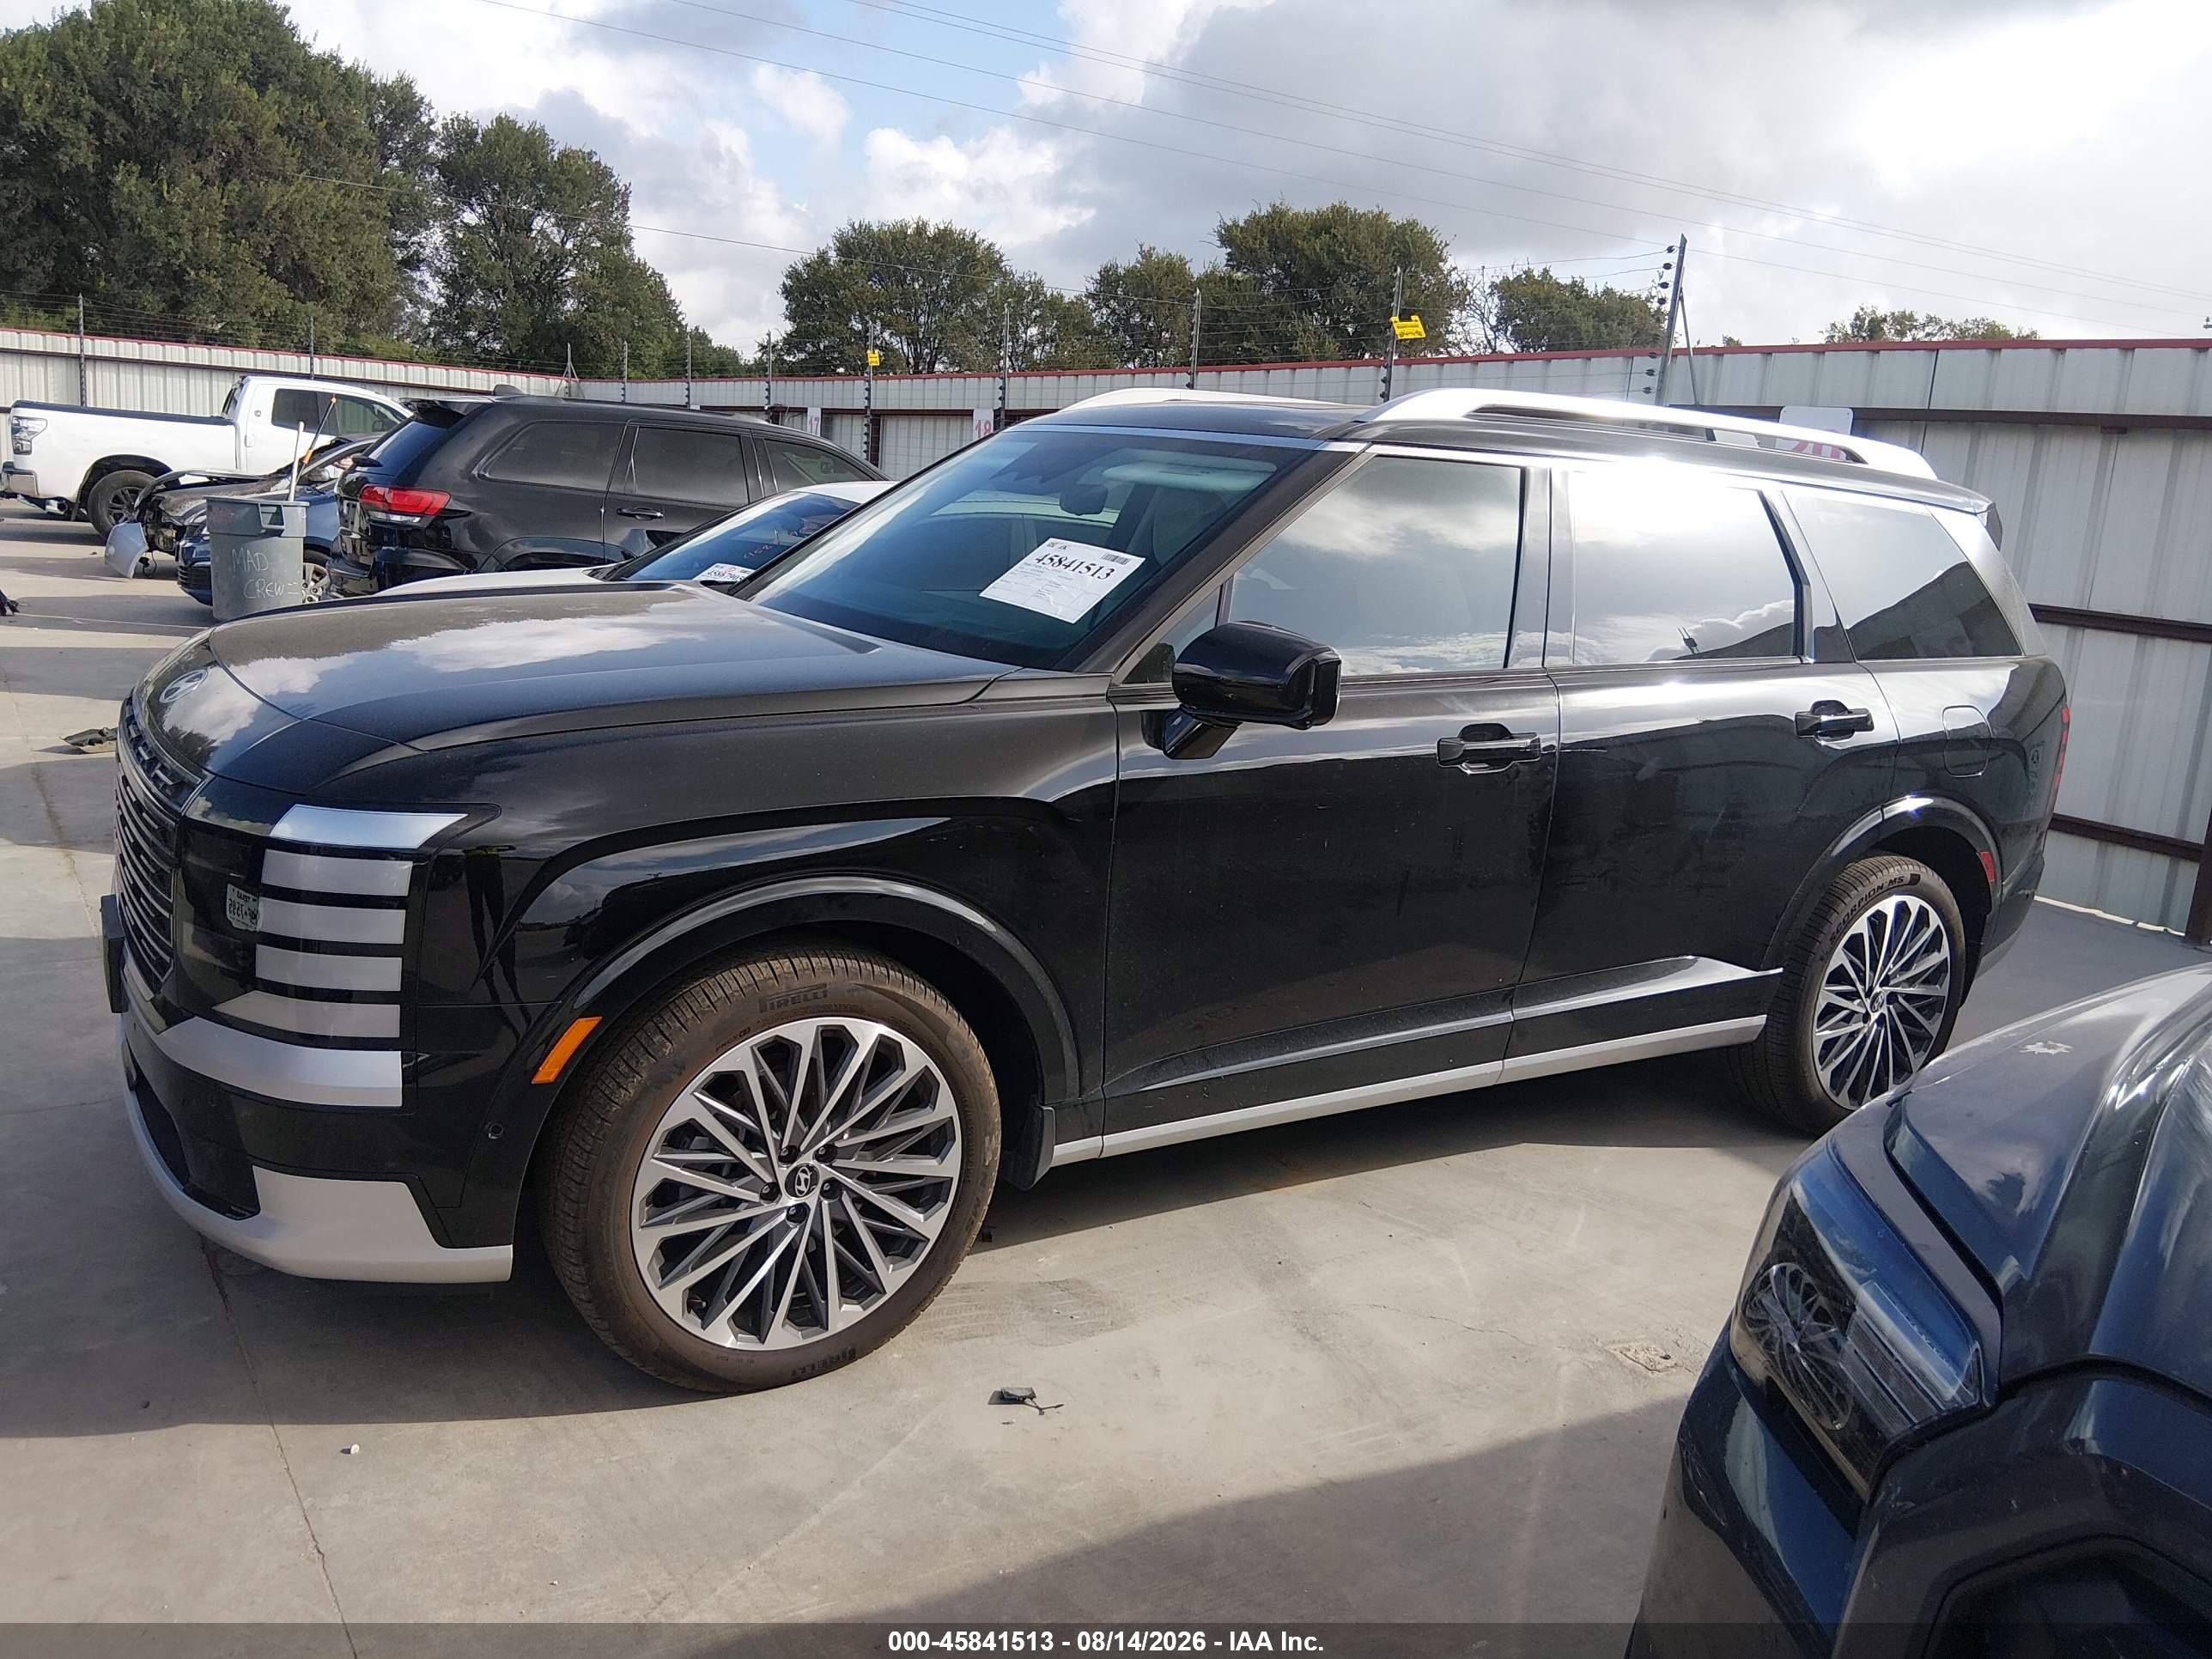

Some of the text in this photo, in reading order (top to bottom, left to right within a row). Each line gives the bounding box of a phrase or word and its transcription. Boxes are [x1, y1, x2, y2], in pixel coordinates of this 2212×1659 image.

[809, 416, 820, 434] 17
[232, 547, 269, 573] MAD
[1036, 553, 1115, 580] 45841513
[243, 578, 285, 599] CREW
[1829, 876, 1905, 945] SCORPION MS
[758, 984, 828, 1014] PIRELLI
